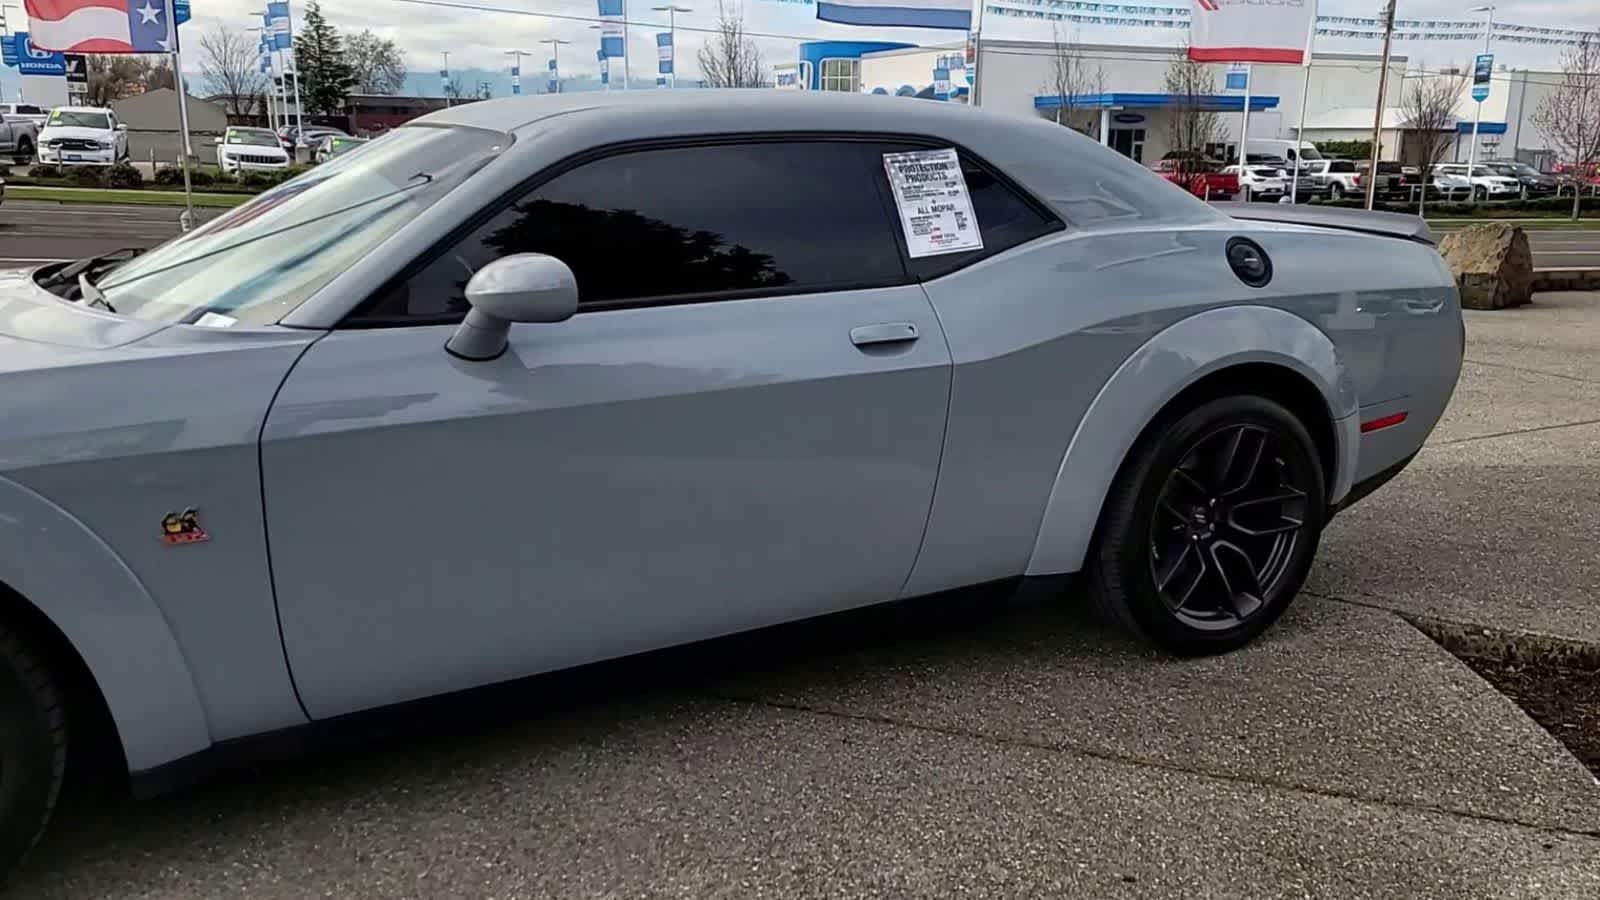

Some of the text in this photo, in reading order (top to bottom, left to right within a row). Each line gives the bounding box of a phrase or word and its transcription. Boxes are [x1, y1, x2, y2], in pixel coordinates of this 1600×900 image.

[899, 162, 948, 174] PROTECTION
[905, 172, 948, 183] PRODUCTS
[917, 203, 955, 214] ALL MOPAR
